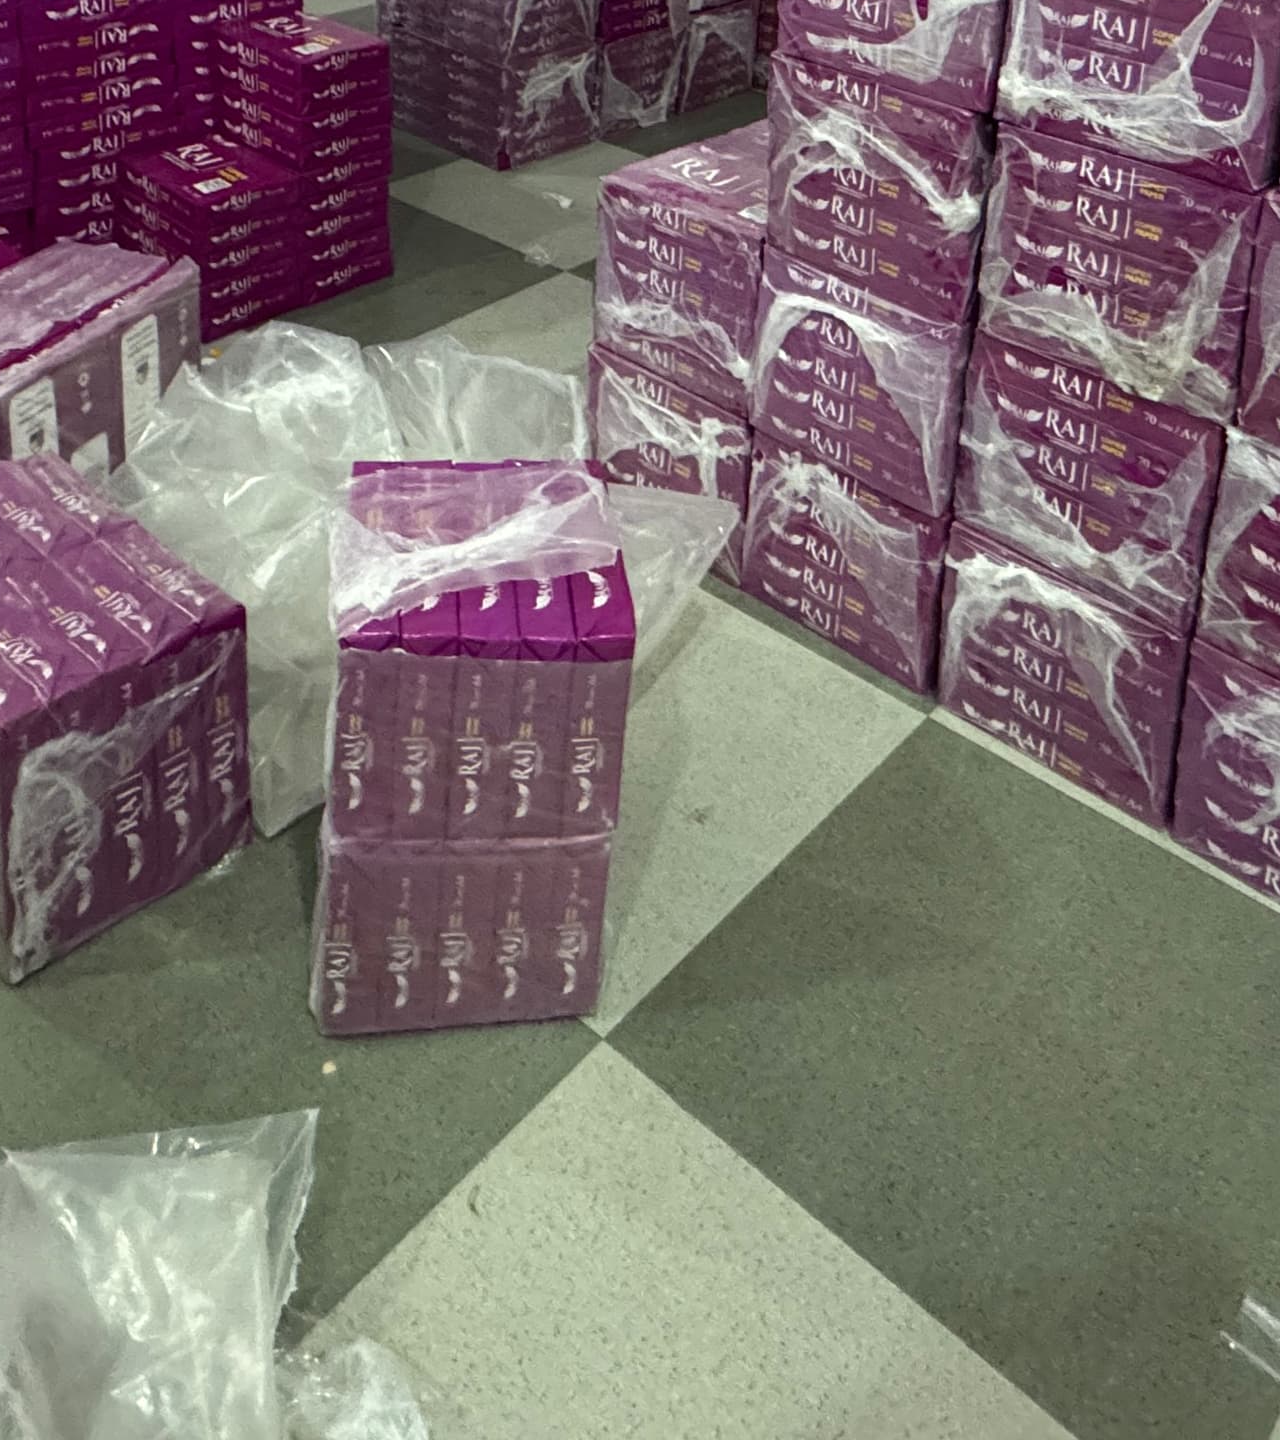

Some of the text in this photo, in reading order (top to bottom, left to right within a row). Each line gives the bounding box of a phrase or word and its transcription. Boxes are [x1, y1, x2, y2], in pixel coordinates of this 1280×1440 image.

[1092, 9, 1136, 41] RAJ
[92, 136, 117, 151] RAJ
[673, 158, 740, 186] RAJ
[1080, 157, 1123, 192] RAJ
[832, 198, 864, 228] RAJ
[1076, 197, 1117, 232] RAJ
[648, 237, 676, 264] RAJ
[834, 237, 865, 268] RAJ
[1067, 243, 1108, 277] RAJ
[1052, 365, 1092, 402] RAJ
[1046, 408, 1086, 445] RAJ
[1039, 446, 1076, 482] RAJ
[458, 746, 482, 775] RAJ
[510, 749, 534, 779] RAJ
[573, 745, 595, 774] RAJ
